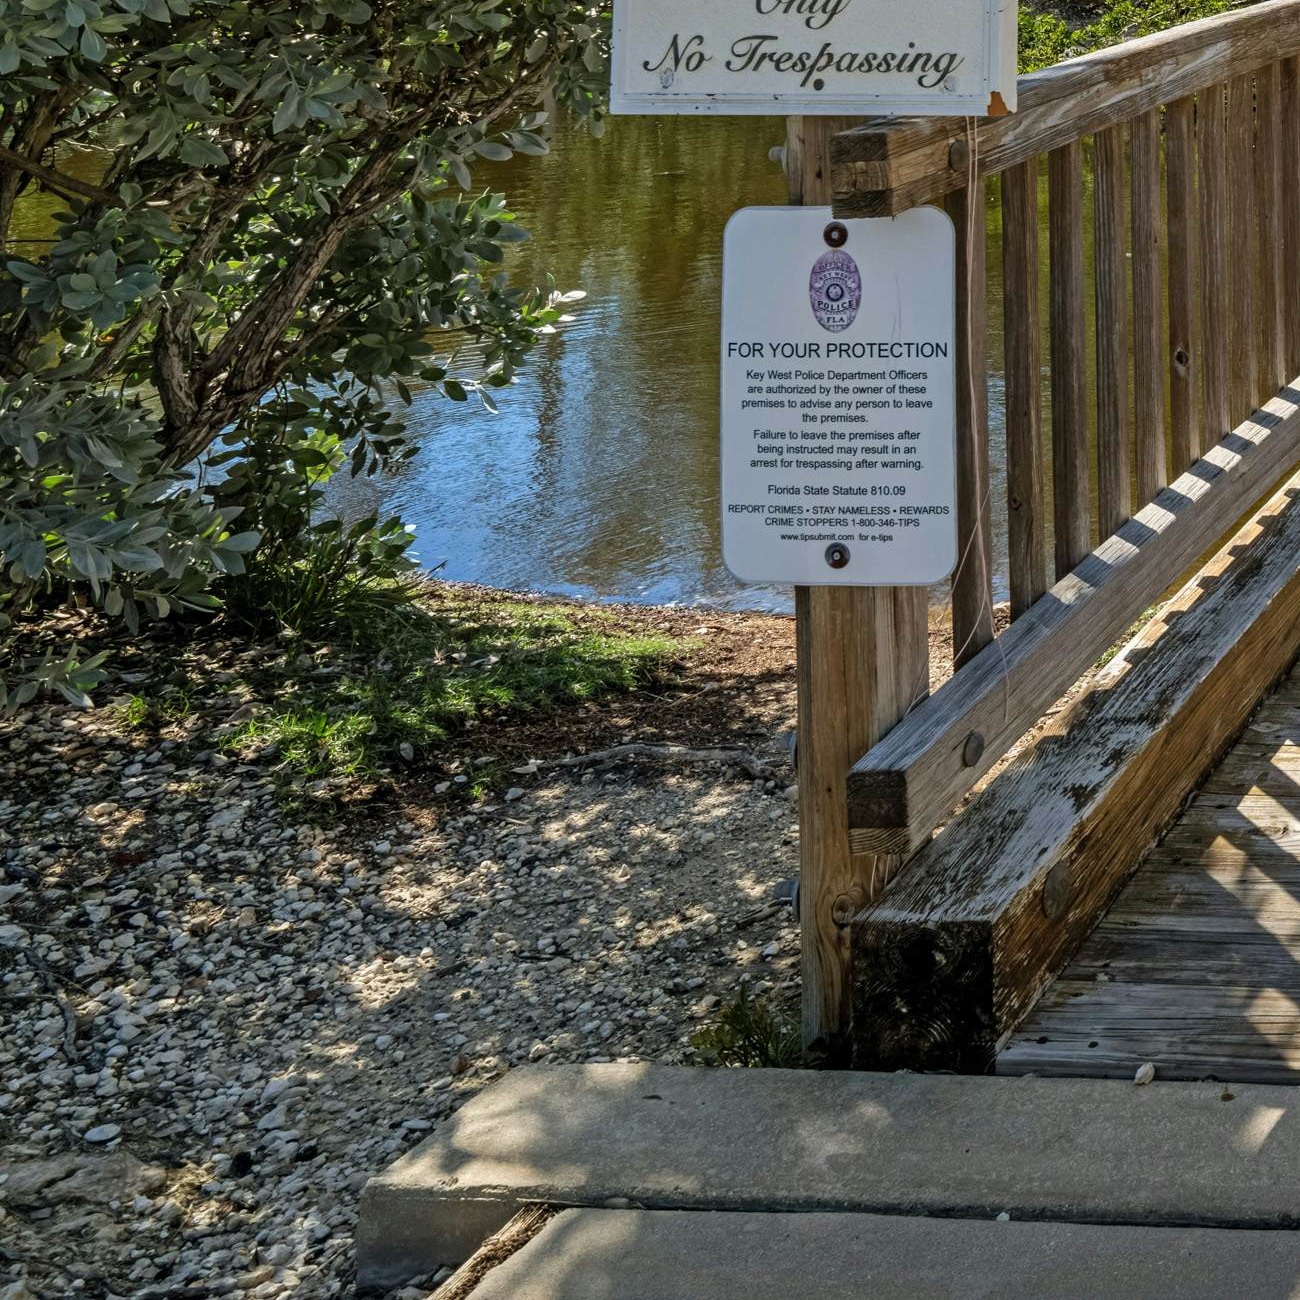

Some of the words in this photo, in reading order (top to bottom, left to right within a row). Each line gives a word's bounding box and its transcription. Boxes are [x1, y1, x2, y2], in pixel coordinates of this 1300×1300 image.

[643, 35, 712, 73] No
[725, 36, 964, 88] Trespassing
[820, 272, 832, 280] KEY
[835, 272, 851, 280] WEST
[817, 300, 854, 311] POLICE
[728, 343, 764, 358] FOR
[769, 343, 820, 358] YOUR
[827, 343, 948, 358] PROTECTION
[747, 371, 764, 381] Key
[768, 371, 792, 379] West
[795, 371, 824, 379] Police
[828, 371, 885, 381] Department
[889, 371, 927, 380] Officers
[766, 385, 816, 394] authorized
[819, 385, 831, 396] by
[834, 385, 849, 394] the
[886, 385, 896, 394] of
[899, 386, 926, 394] these
[742, 400, 785, 410] premises
[788, 400, 797, 408] to
[800, 400, 831, 408] advise
[835, 401, 852, 410] any
[856, 401, 890, 410] person
[893, 400, 902, 408] to
[906, 400, 932, 408] leave
[803, 414, 817, 422] the
[821, 415, 868, 424] premises.
[754, 430, 786, 439] Failure
[789, 431, 798, 439] to
[801, 431, 827, 439] leave
[830, 431, 845, 439] the
[849, 431, 894, 441] premises
[897, 431, 920, 440] after
[758, 445, 783, 455] being
[786, 445, 833, 454] instructed
[837, 446, 857, 456] may
[861, 445, 888, 454] result
[892, 445, 900, 454] in
[780, 459, 792, 467] for
[796, 460, 852, 470] trespassing
[855, 460, 877, 468] after
[881, 460, 923, 470] warning.
[768, 485, 800, 494] Florida
[803, 486, 829, 495] State
[833, 486, 867, 496] Statute
[871, 487, 905, 496] 810.09
[728, 505, 765, 513] REPORT
[768, 506, 803, 514] CRIMES
[812, 506, 835, 514] STAY
[838, 507, 890, 515] NAMELESS
[900, 507, 949, 515] REWARDS
[765, 518, 794, 526] CRIME
[797, 518, 848, 527] STOPPERS
[852, 519, 920, 527] 1-800-346-TIPS
